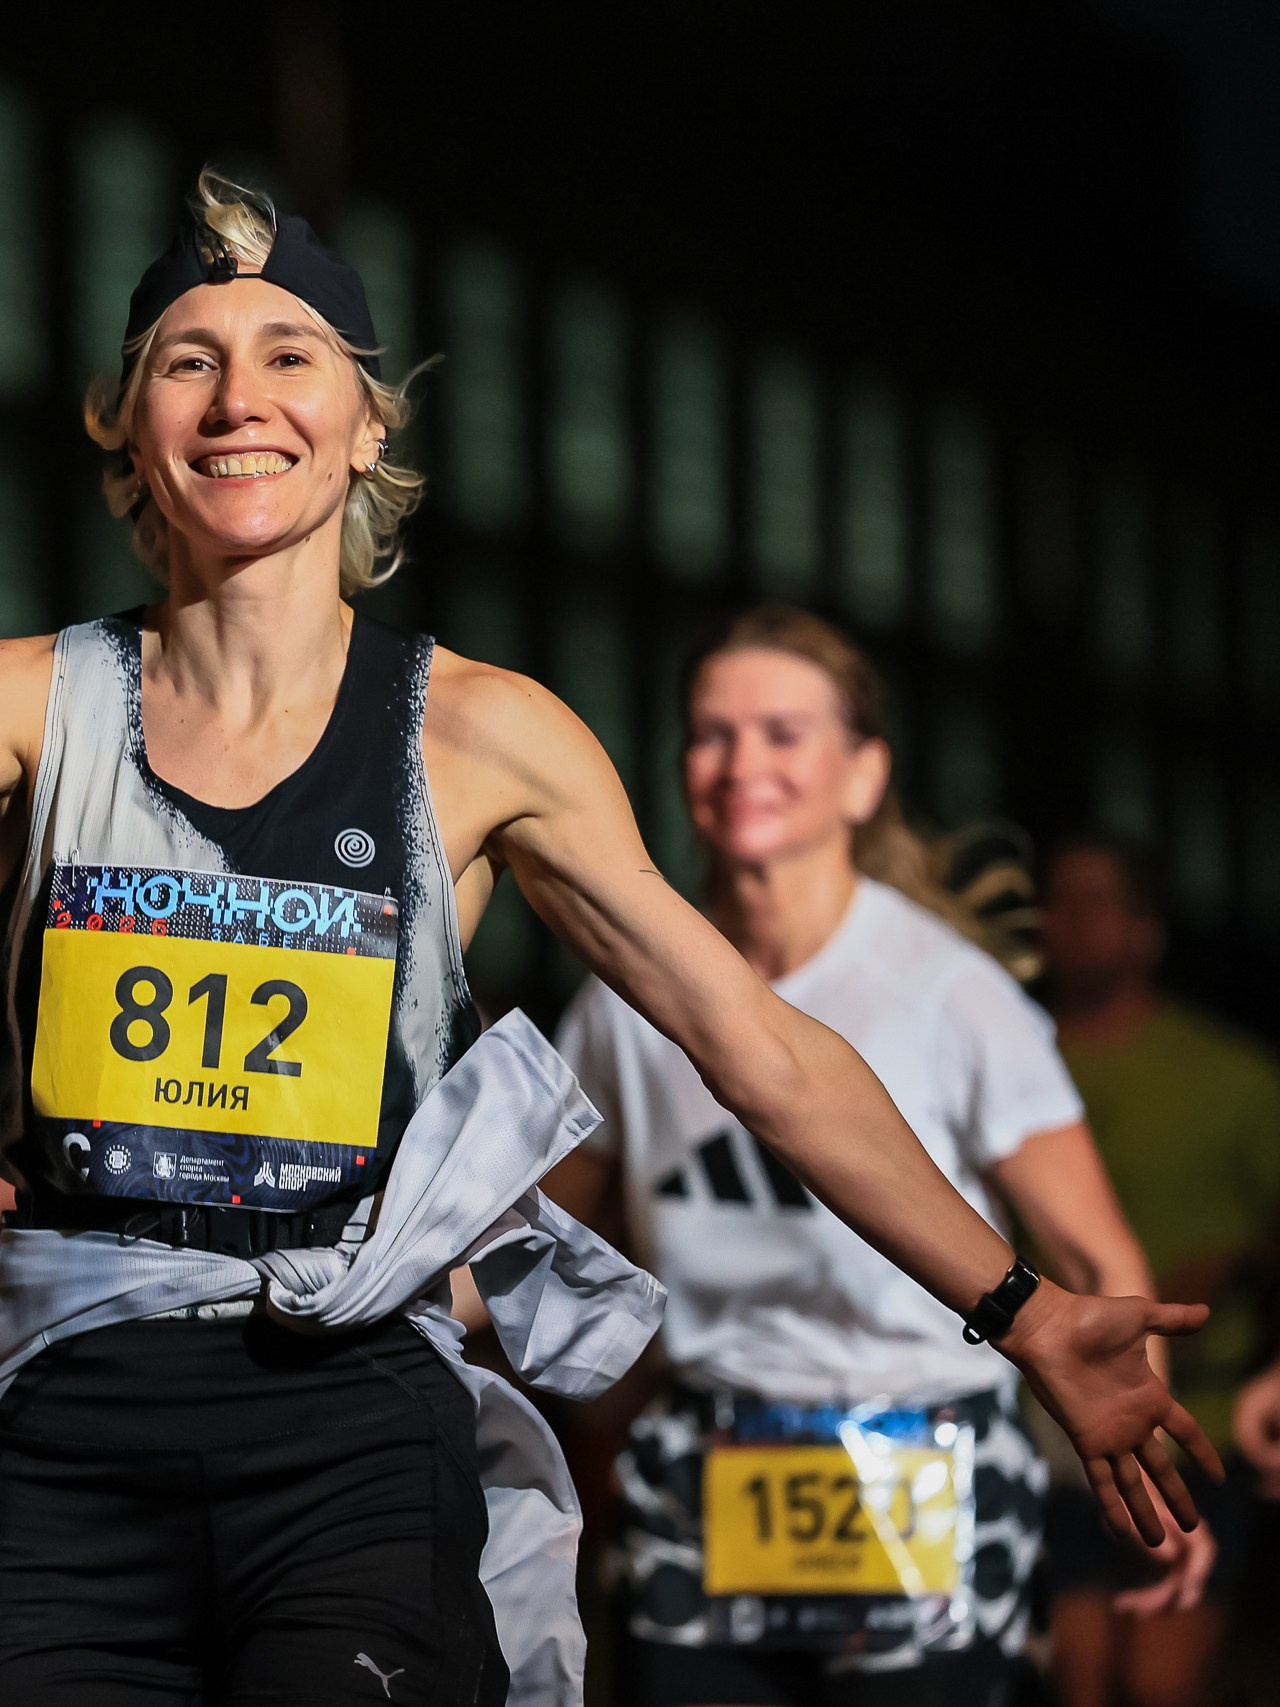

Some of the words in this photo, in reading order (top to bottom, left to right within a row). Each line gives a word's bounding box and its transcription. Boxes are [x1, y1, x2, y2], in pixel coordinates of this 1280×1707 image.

[210, 927, 315, 952] ЗАБЕГ
[109, 965, 308, 1077] 812
[153, 1077, 250, 1111] ЮЛИЯ
[179, 1155, 224, 1167] Департамент
[179, 1164, 203, 1173] спорта
[178, 1171, 202, 1182] города
